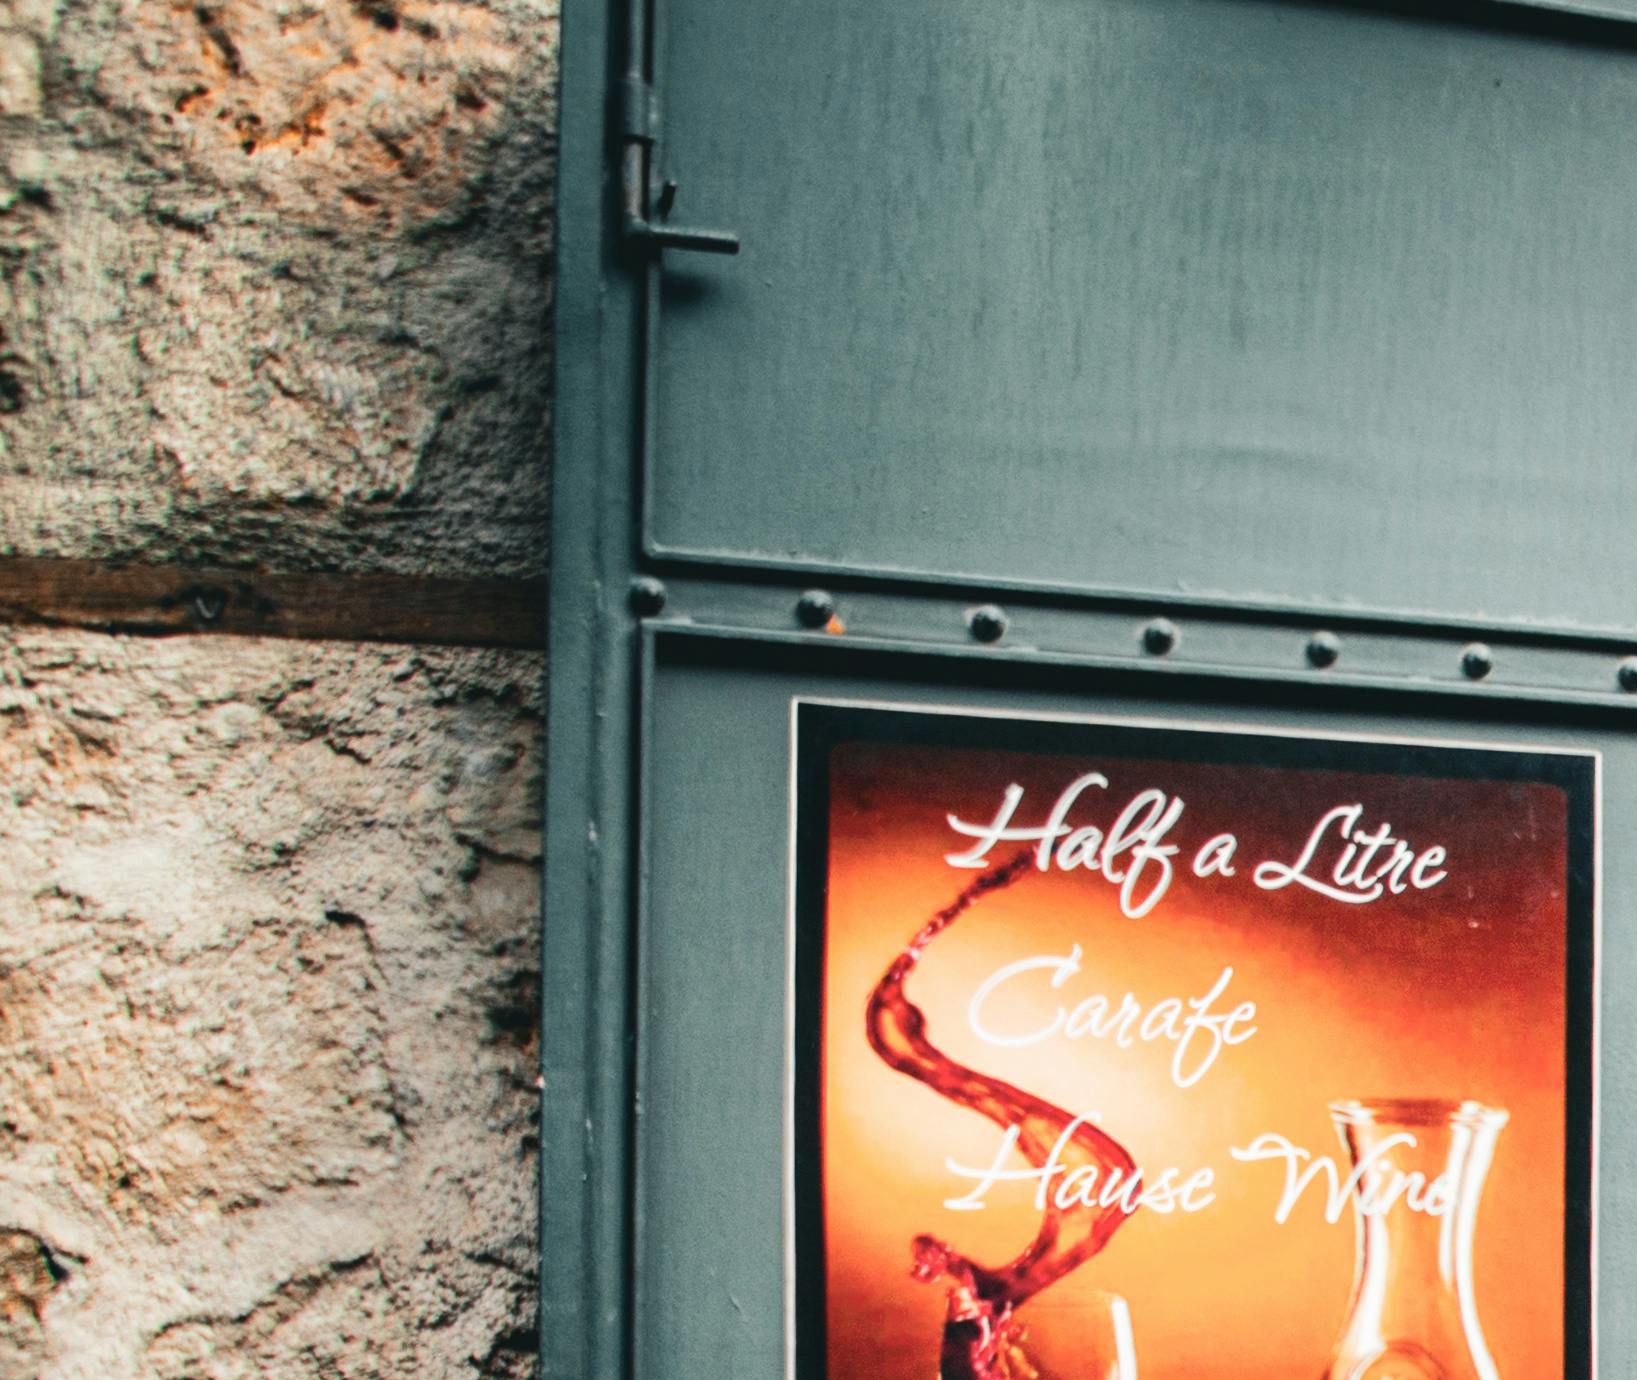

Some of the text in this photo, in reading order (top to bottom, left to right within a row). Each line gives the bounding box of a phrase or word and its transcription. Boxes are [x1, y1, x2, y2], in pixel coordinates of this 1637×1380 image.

[946, 773, 1448, 917] Half a Litre
[967, 944, 1257, 1087] Carafe
